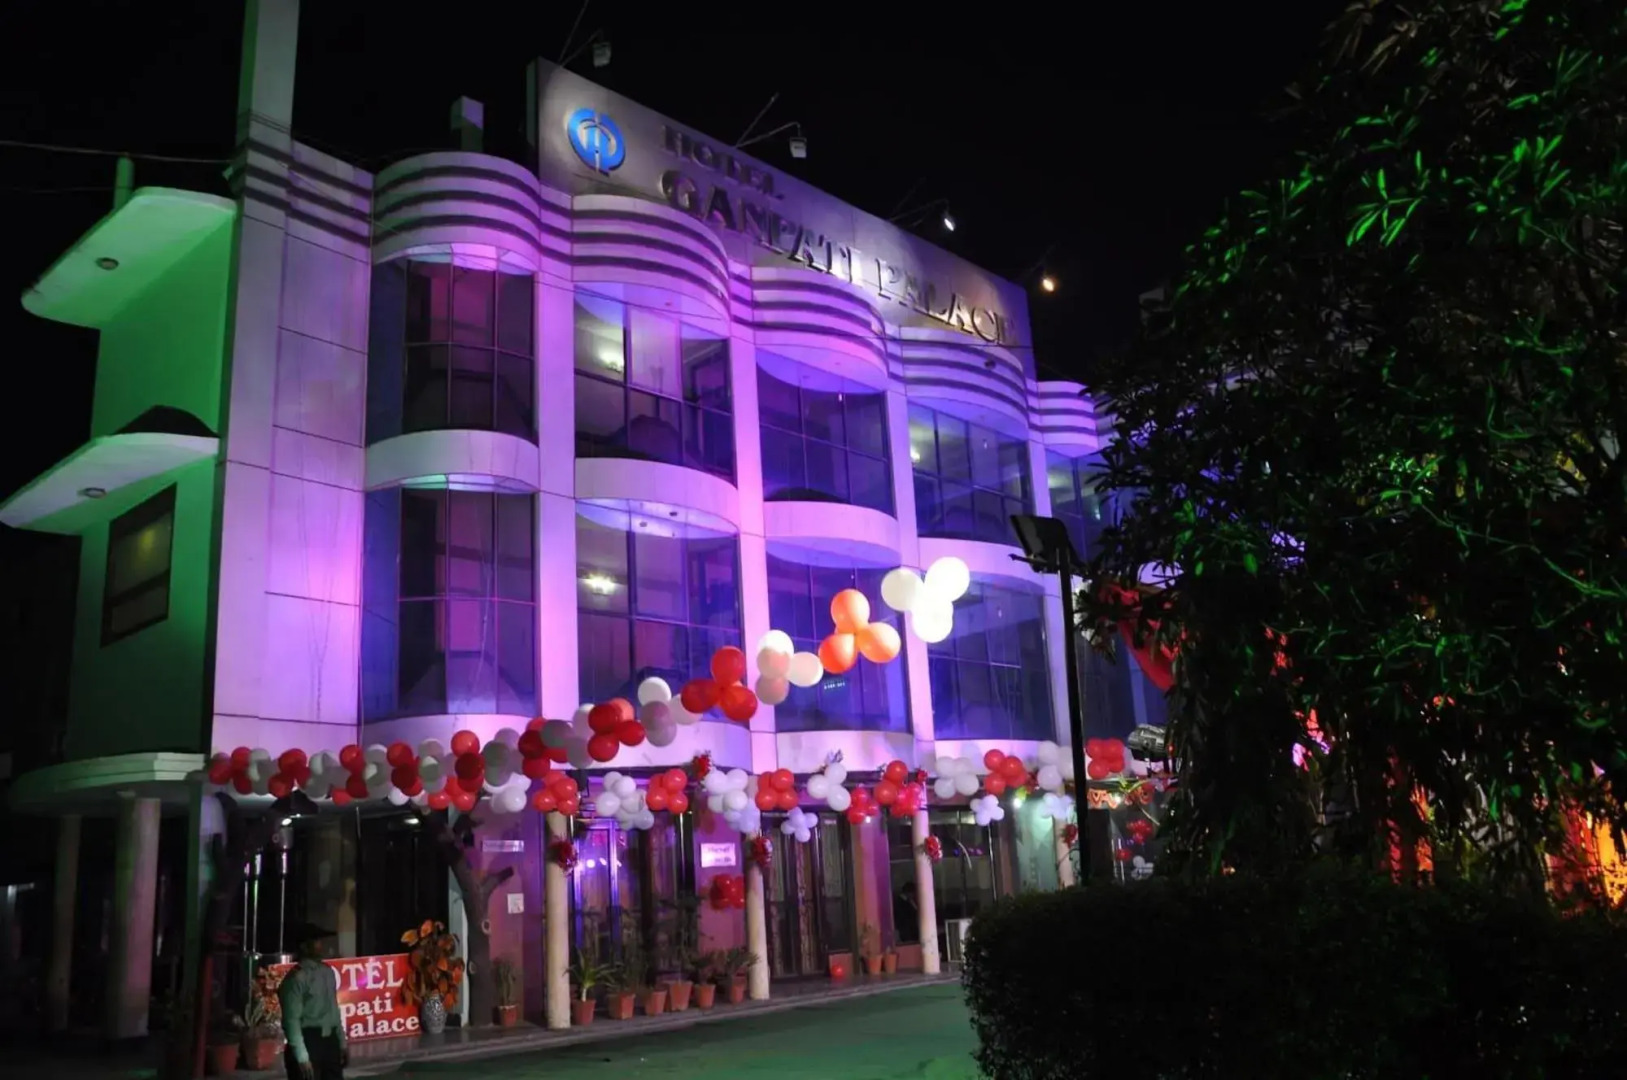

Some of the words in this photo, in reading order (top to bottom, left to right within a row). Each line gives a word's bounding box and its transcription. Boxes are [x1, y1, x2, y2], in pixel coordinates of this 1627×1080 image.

[661, 123, 782, 200] HOTEL
[656, 168, 862, 286] GANPATI
[338, 991, 394, 1023] pati
[345, 1013, 420, 1039] alace
